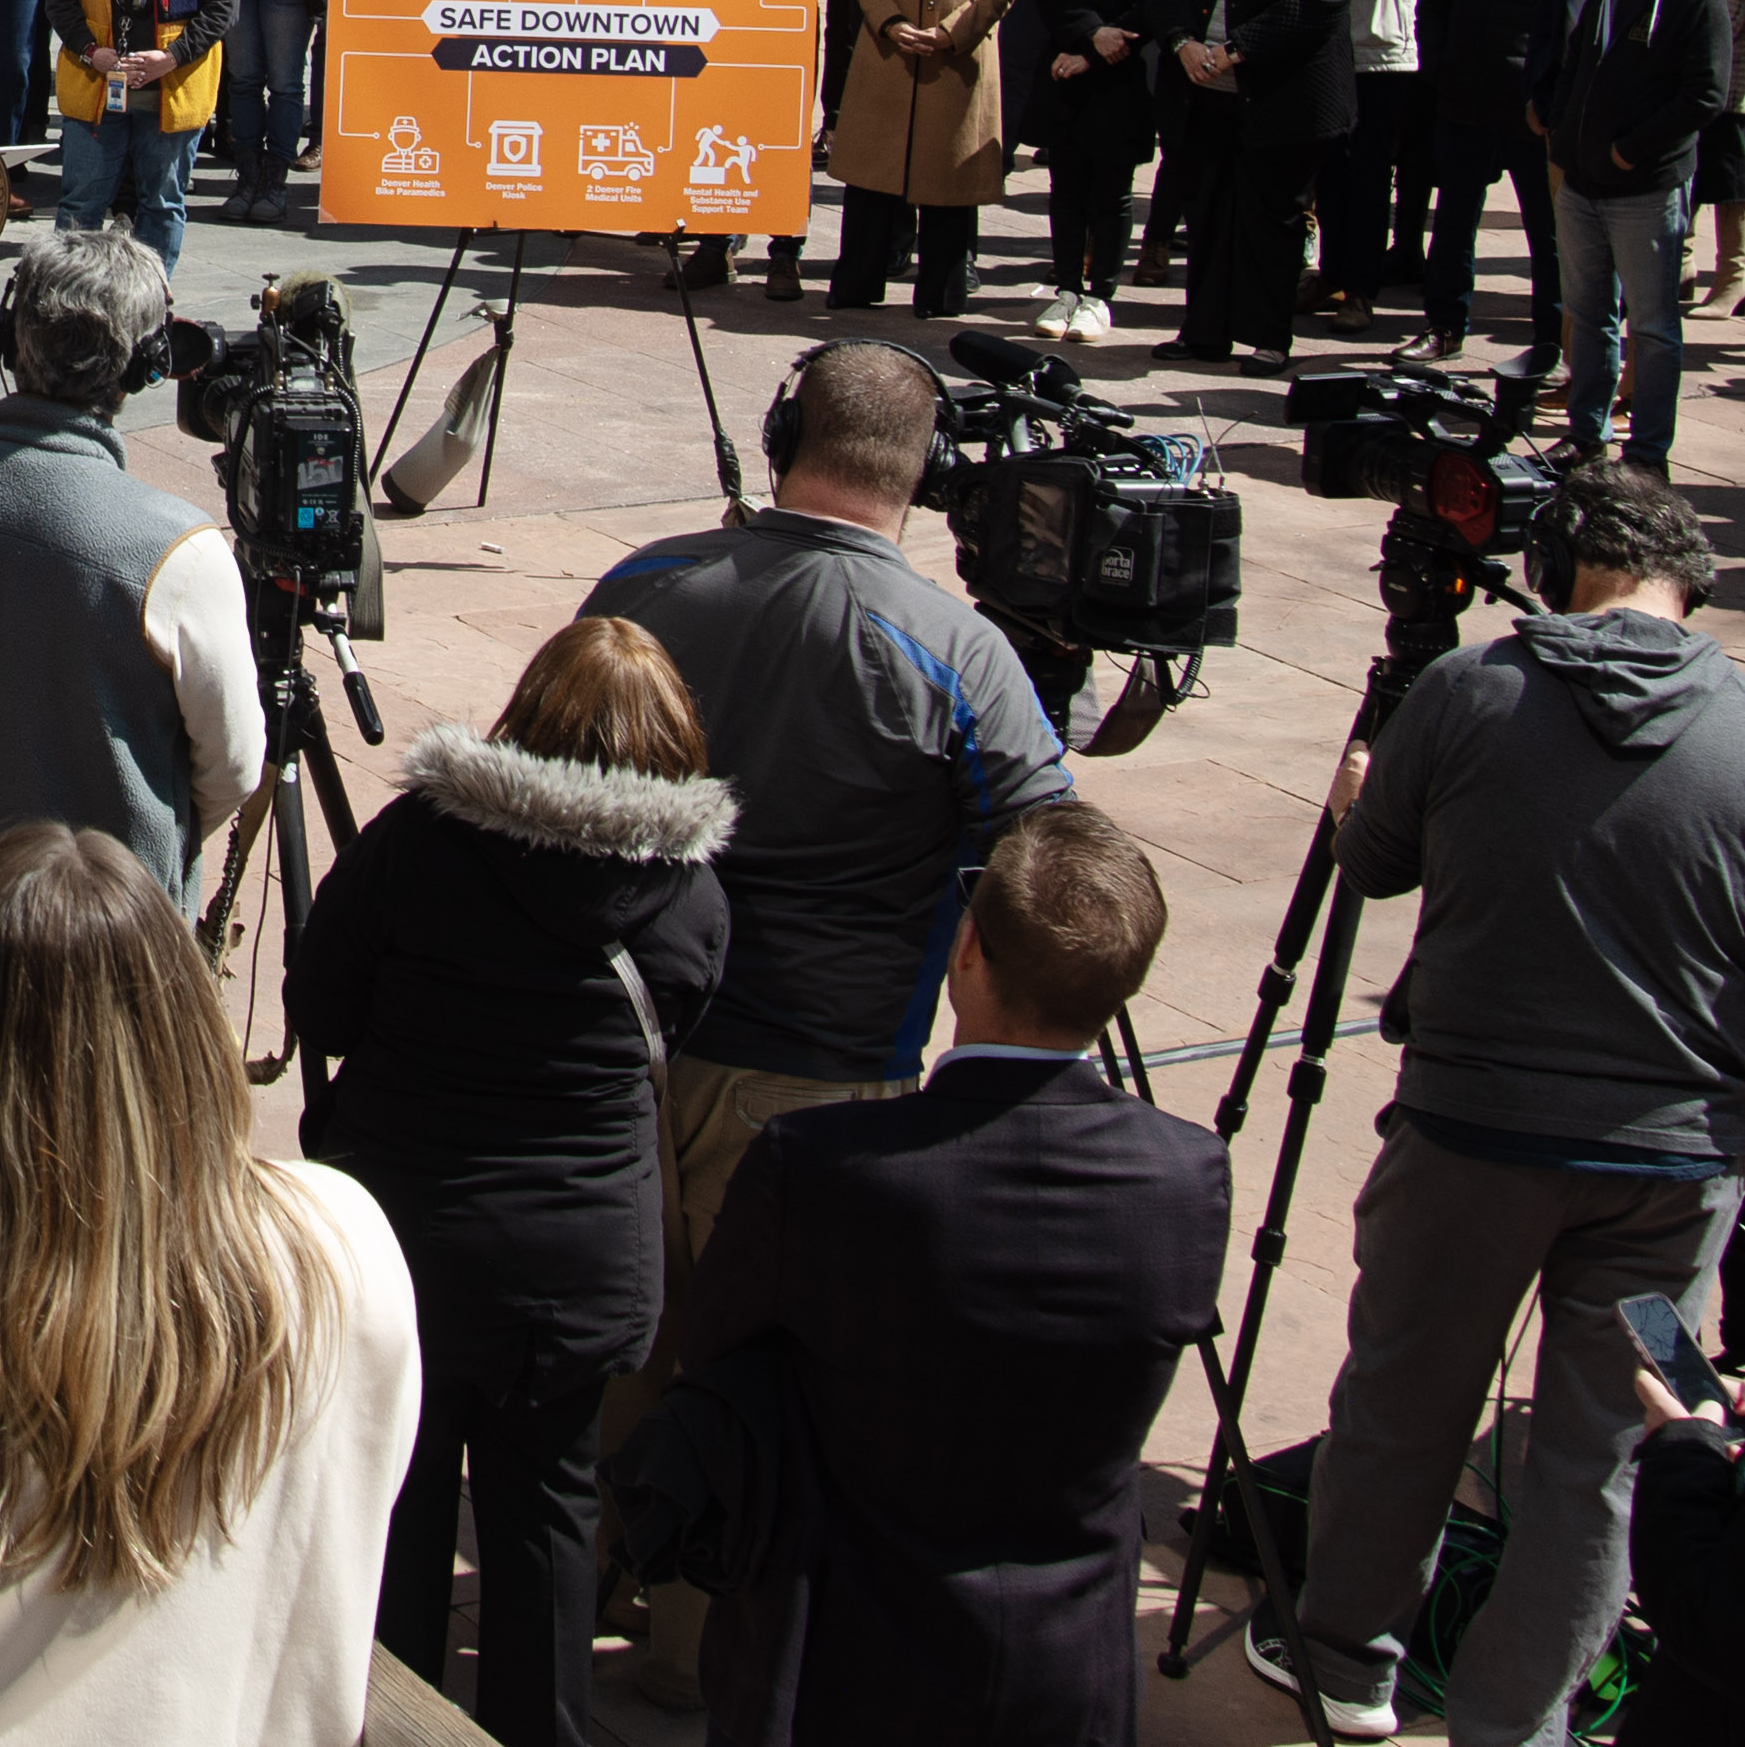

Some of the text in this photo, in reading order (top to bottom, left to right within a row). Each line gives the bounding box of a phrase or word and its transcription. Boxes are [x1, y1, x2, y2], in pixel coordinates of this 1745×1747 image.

[439, 7, 701, 37] SAFE DOWNTOWN
[471, 44, 666, 72] ACTION PLAN
[381, 178, 440, 189] Denver Health
[485, 182, 543, 192] Denver Police
[375, 187, 446, 197] Bike Paramedics
[595, 185, 624, 194] Denver
[626, 186, 642, 194] Fire
[683, 187, 713, 196] Mental
[714, 189, 741, 197] Health
[502, 191, 526, 199] Kiosk
[585, 193, 642, 203] Medical Units
[690, 196, 751, 205] Substance Use
[692, 205, 748, 214] Support Team
